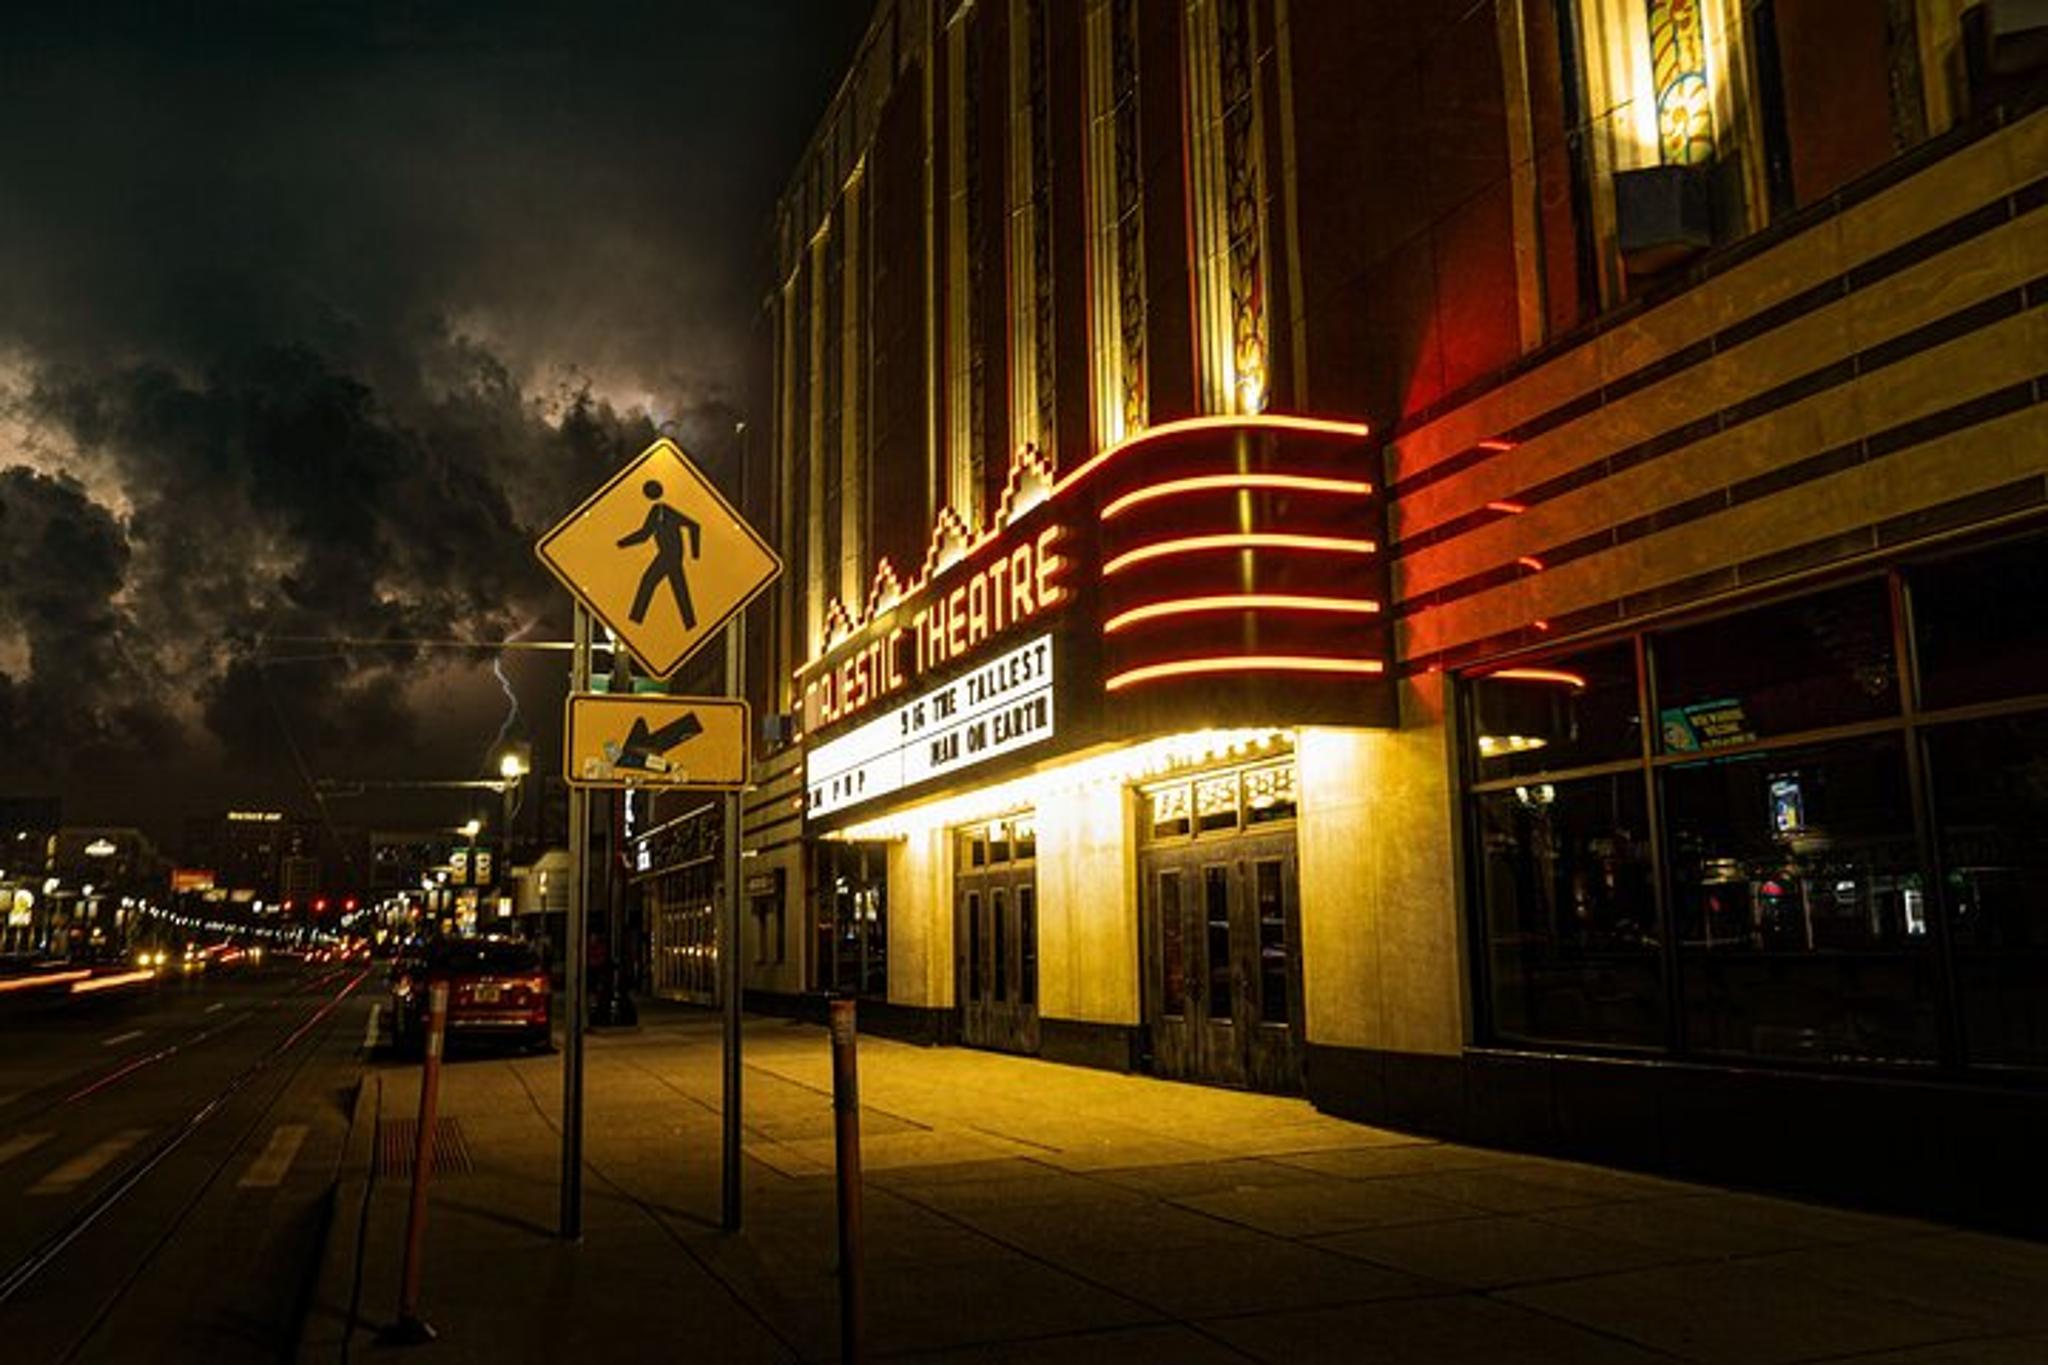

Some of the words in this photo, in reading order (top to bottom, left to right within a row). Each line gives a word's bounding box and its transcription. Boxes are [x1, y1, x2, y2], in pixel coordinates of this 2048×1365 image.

[914, 525, 1062, 673] THEATRE
[933, 687, 957, 722] THE
[967, 644, 1046, 706] TALLEST
[930, 733, 958, 767] MAN
[967, 721, 987, 753] ON
[994, 696, 1047, 745] EARTH
